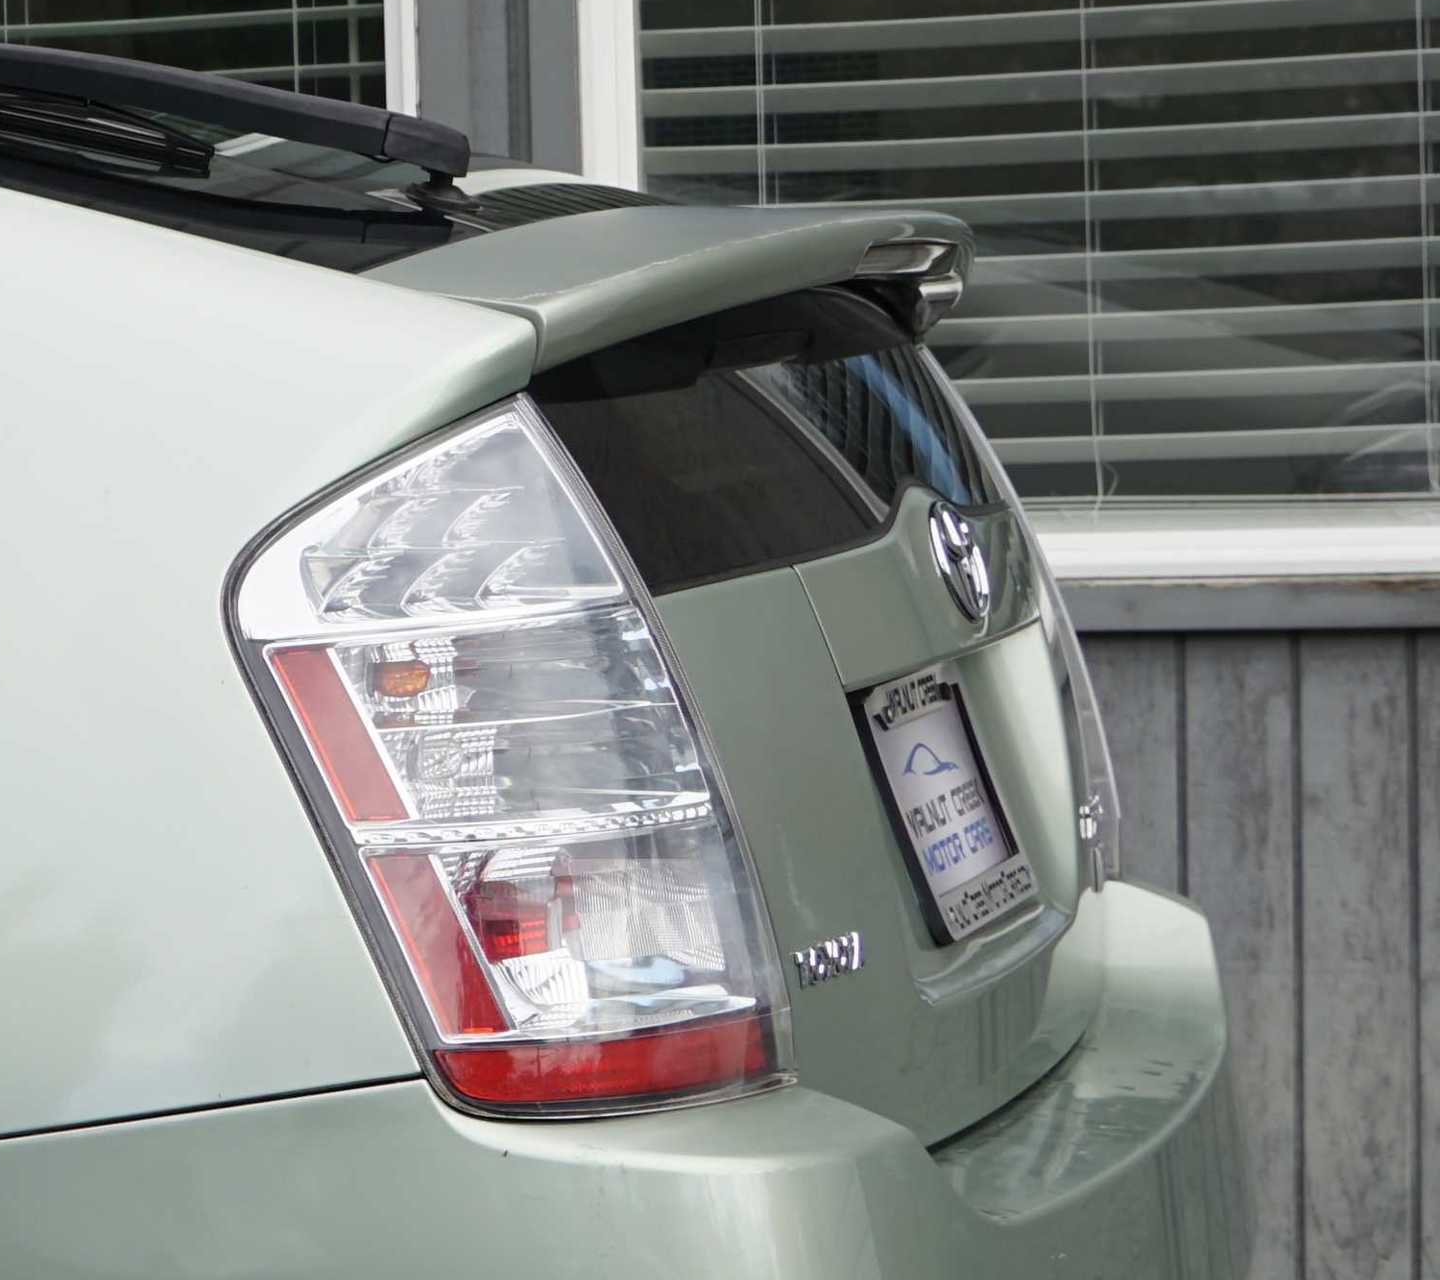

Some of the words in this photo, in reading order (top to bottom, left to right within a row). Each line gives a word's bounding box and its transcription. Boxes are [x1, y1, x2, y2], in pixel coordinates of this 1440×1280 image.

[905, 794, 952, 840] WALNUT
[922, 832, 967, 876] MOTOR
[963, 816, 994, 854] CARS
